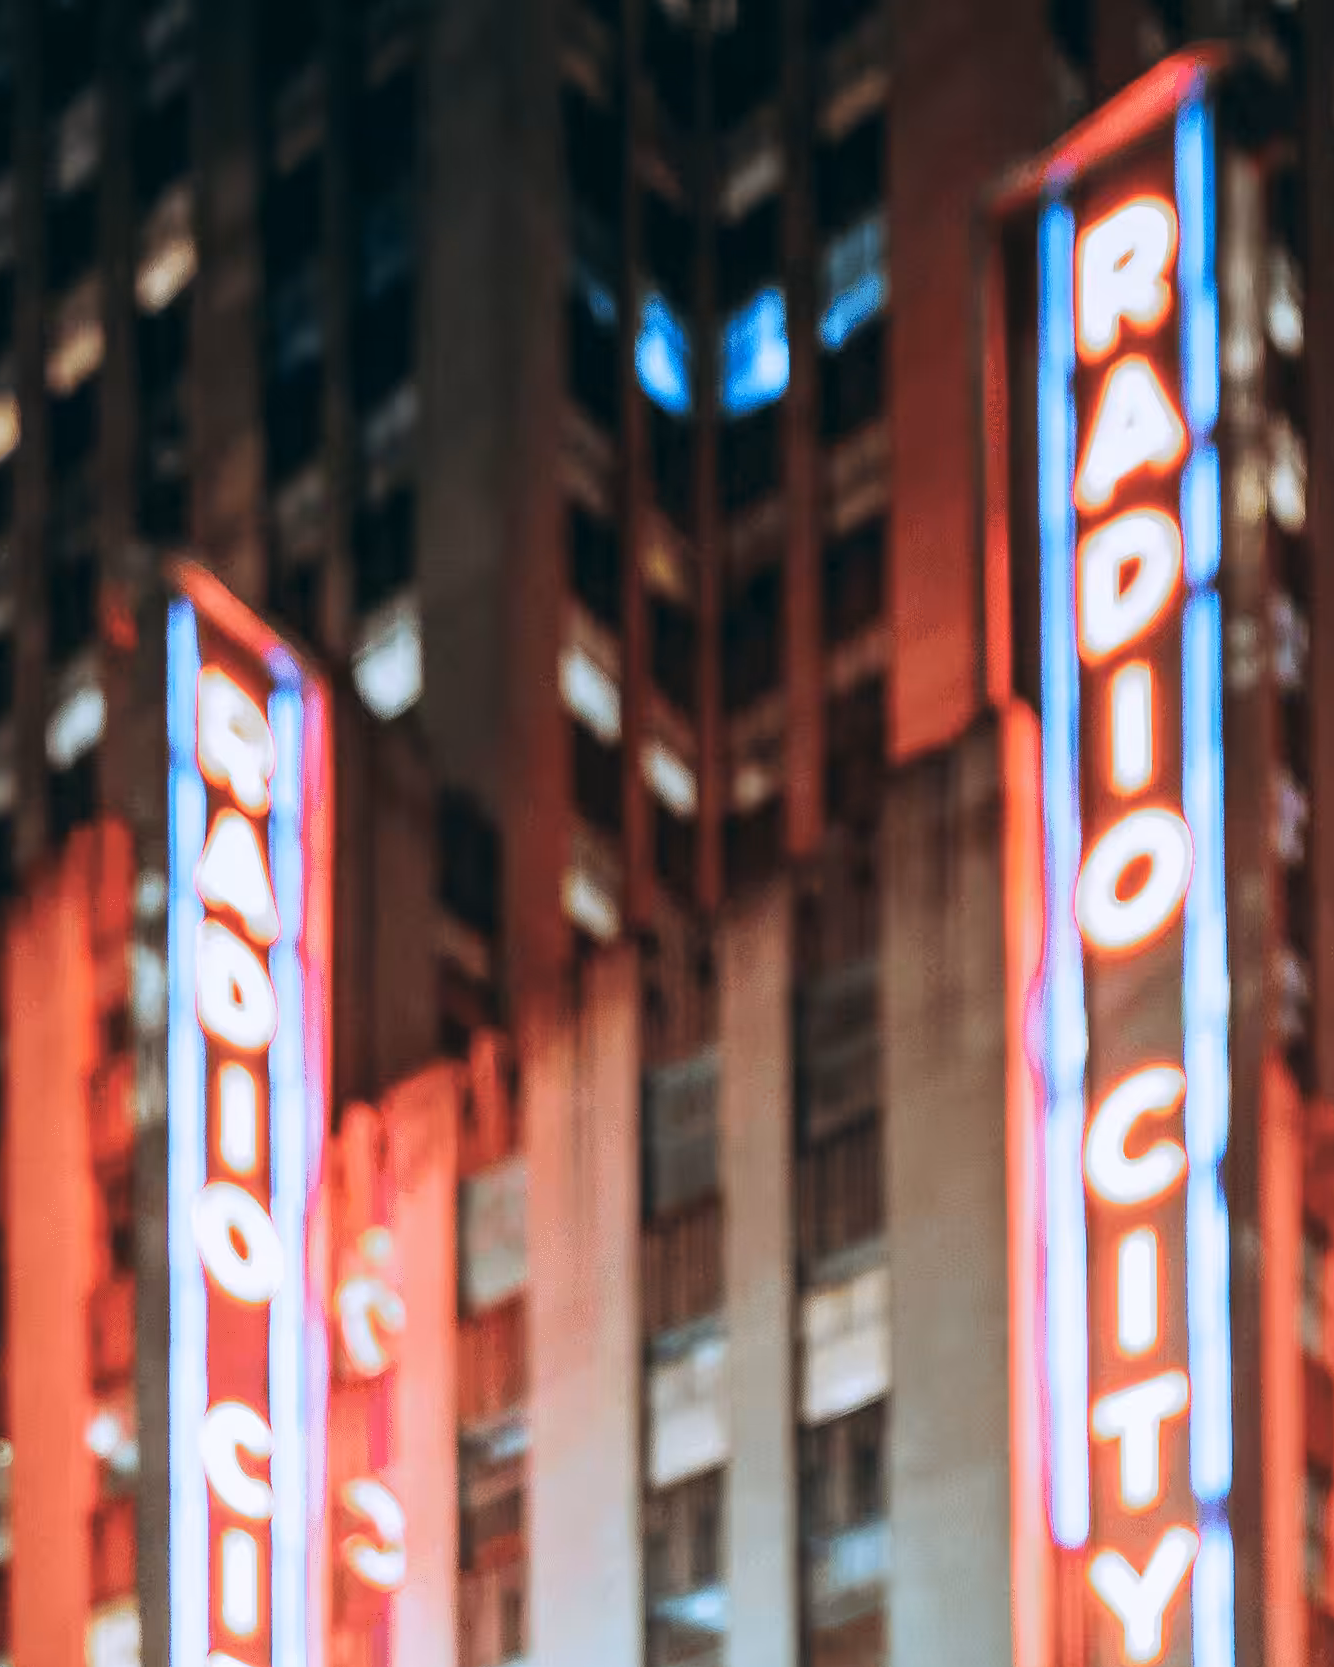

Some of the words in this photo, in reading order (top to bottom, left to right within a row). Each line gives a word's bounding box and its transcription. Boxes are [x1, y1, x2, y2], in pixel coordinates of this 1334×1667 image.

[1074, 194, 1195, 956] RADIO
[193, 664, 283, 1304] RADIO
[1083, 1063, 1199, 1667] CITY
